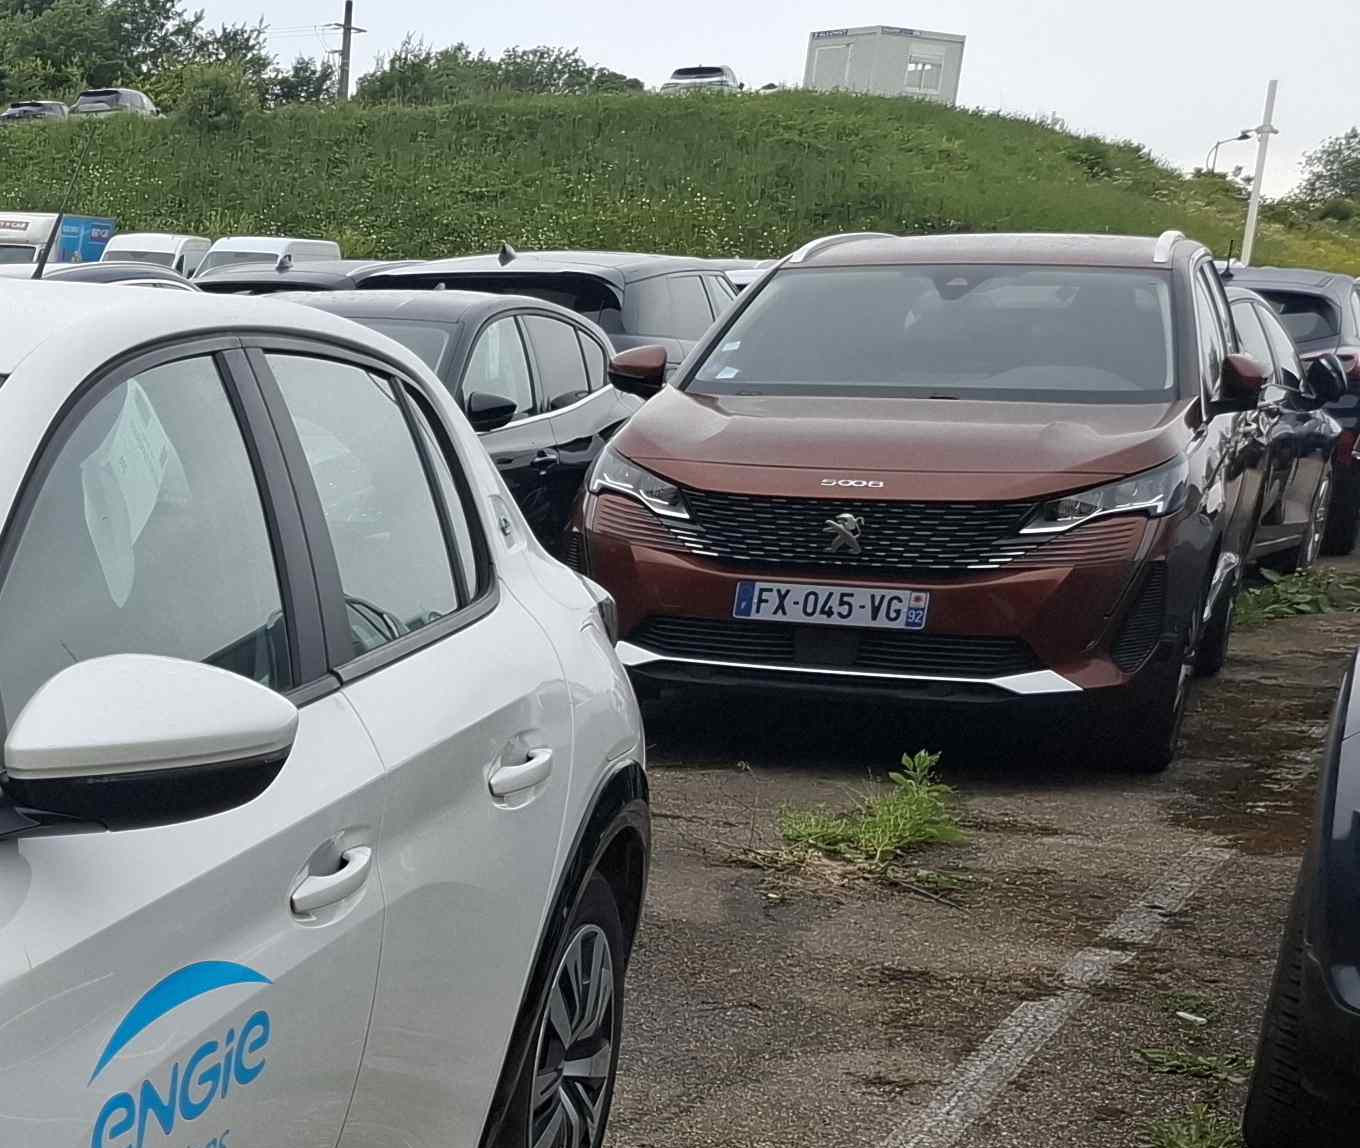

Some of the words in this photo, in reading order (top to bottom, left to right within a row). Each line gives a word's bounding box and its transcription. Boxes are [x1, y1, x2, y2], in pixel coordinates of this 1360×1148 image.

[820, 479, 884, 488] 5008
[755, 588, 904, 622] FX-045-VG
[908, 609, 924, 623] 92
